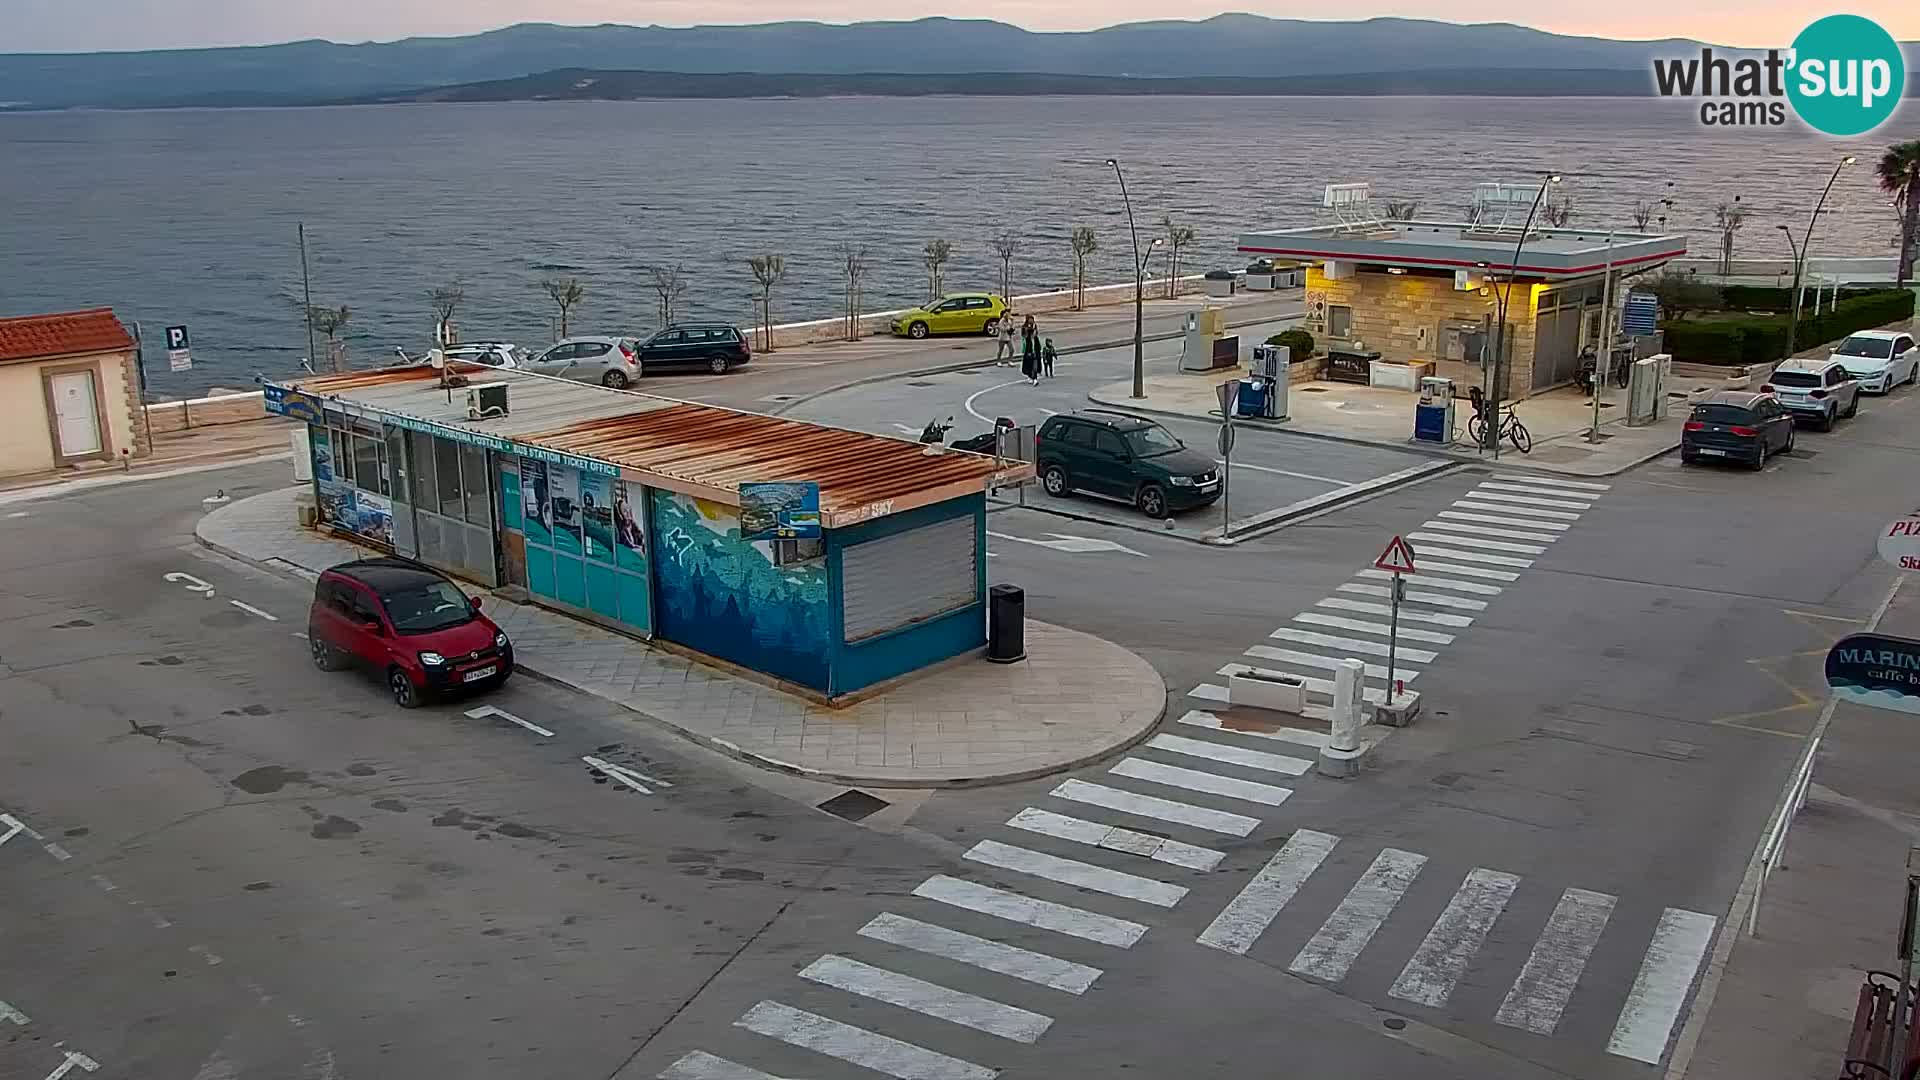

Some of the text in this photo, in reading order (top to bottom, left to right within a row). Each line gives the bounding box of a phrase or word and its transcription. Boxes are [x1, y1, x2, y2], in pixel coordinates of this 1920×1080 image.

[171, 329, 183, 346] P
[528, 447, 560, 463] STATION
[563, 455, 588, 470] TICKET
[590, 461, 616, 476] OFFICE
[1867, 669, 1904, 681] caffe
